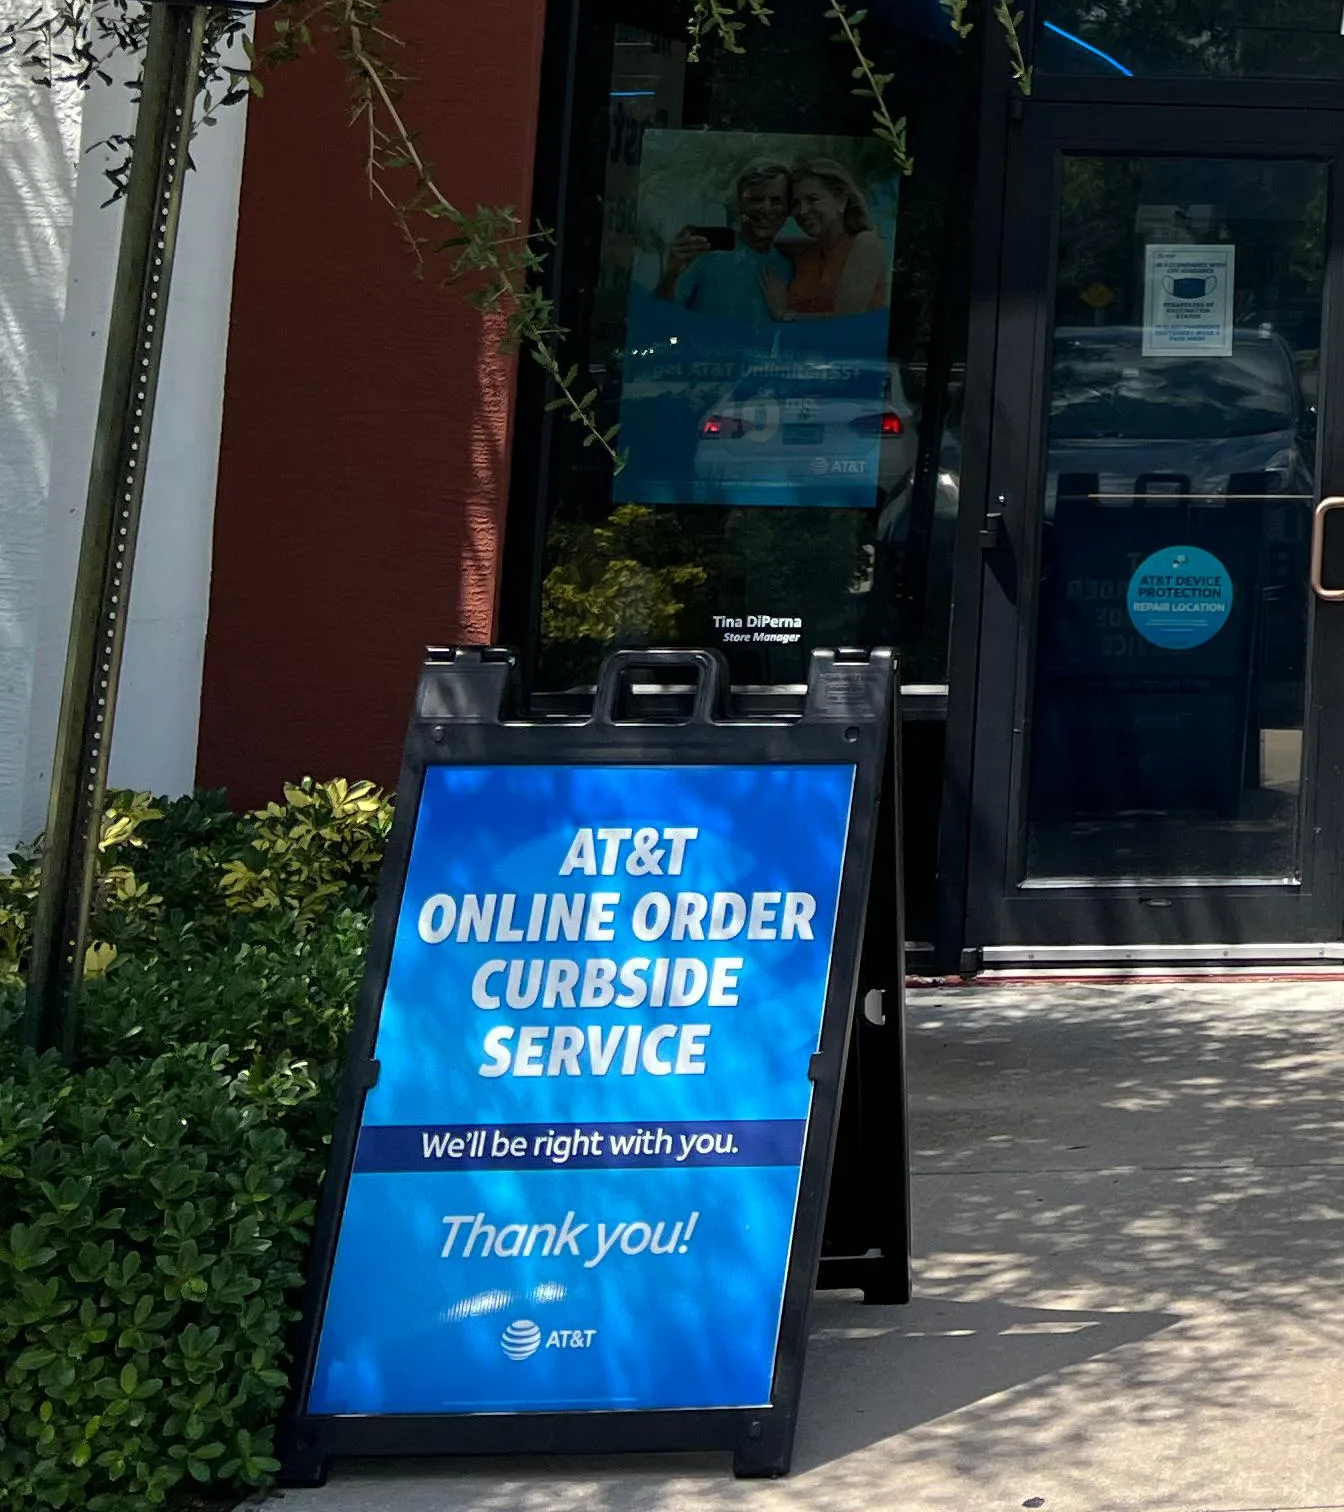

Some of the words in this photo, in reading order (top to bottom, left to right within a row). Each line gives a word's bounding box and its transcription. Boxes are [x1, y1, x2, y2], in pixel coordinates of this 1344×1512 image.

[831, 460, 867, 474] AT&T
[1140, 575, 1173, 587] AT&T
[1176, 575, 1223, 587] DEVICE
[1138, 586, 1222, 599] PROTECTION
[1133, 602, 1170, 612] REPAIR
[1172, 602, 1225, 613] LOCATION
[712, 615, 743, 628] Tina
[747, 615, 802, 628] DiPerna
[723, 632, 751, 642] Store
[752, 632, 801, 644] Manager
[559, 827, 698, 877] AT&T
[417, 892, 620, 944] ONLINE
[631, 891, 816, 942] ORDER
[471, 957, 744, 1010] CURBSIDE
[478, 1024, 711, 1078] SERVICE
[421, 1130, 486, 1159] We'll
[491, 1129, 528, 1158] be
[533, 1128, 604, 1164] right
[609, 1127, 673, 1156] with
[676, 1131, 739, 1162] you.
[440, 1210, 589, 1258] Thank
[583, 1211, 700, 1269] you!
[545, 1329, 597, 1349] AT&T
